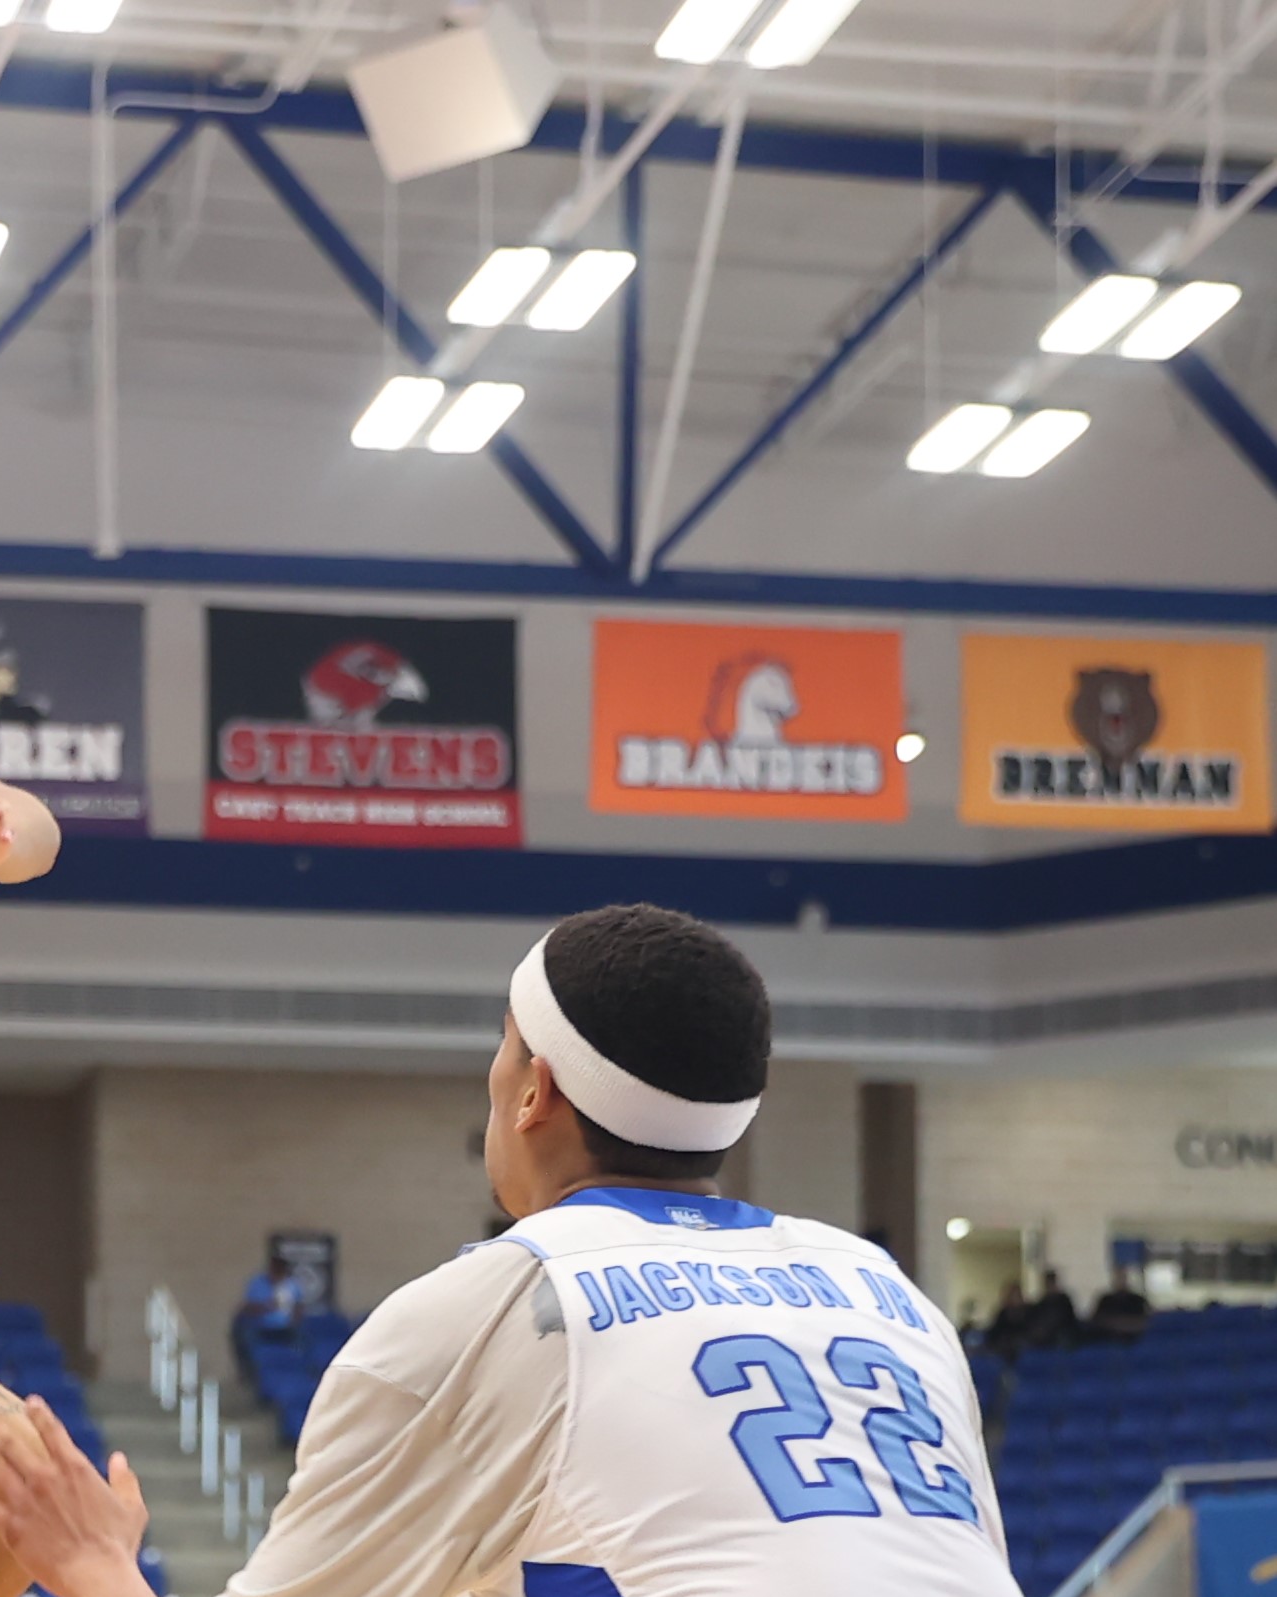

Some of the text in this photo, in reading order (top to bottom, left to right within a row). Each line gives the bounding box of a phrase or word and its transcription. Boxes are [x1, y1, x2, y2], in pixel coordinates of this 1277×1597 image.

[221, 724, 509, 787] STEVENS
[619, 738, 880, 794] BRANDEIS
[998, 754, 1232, 800] BRENNAN
[575, 1260, 930, 1334] JACKSON JR
[691, 1333, 980, 1527] 22
